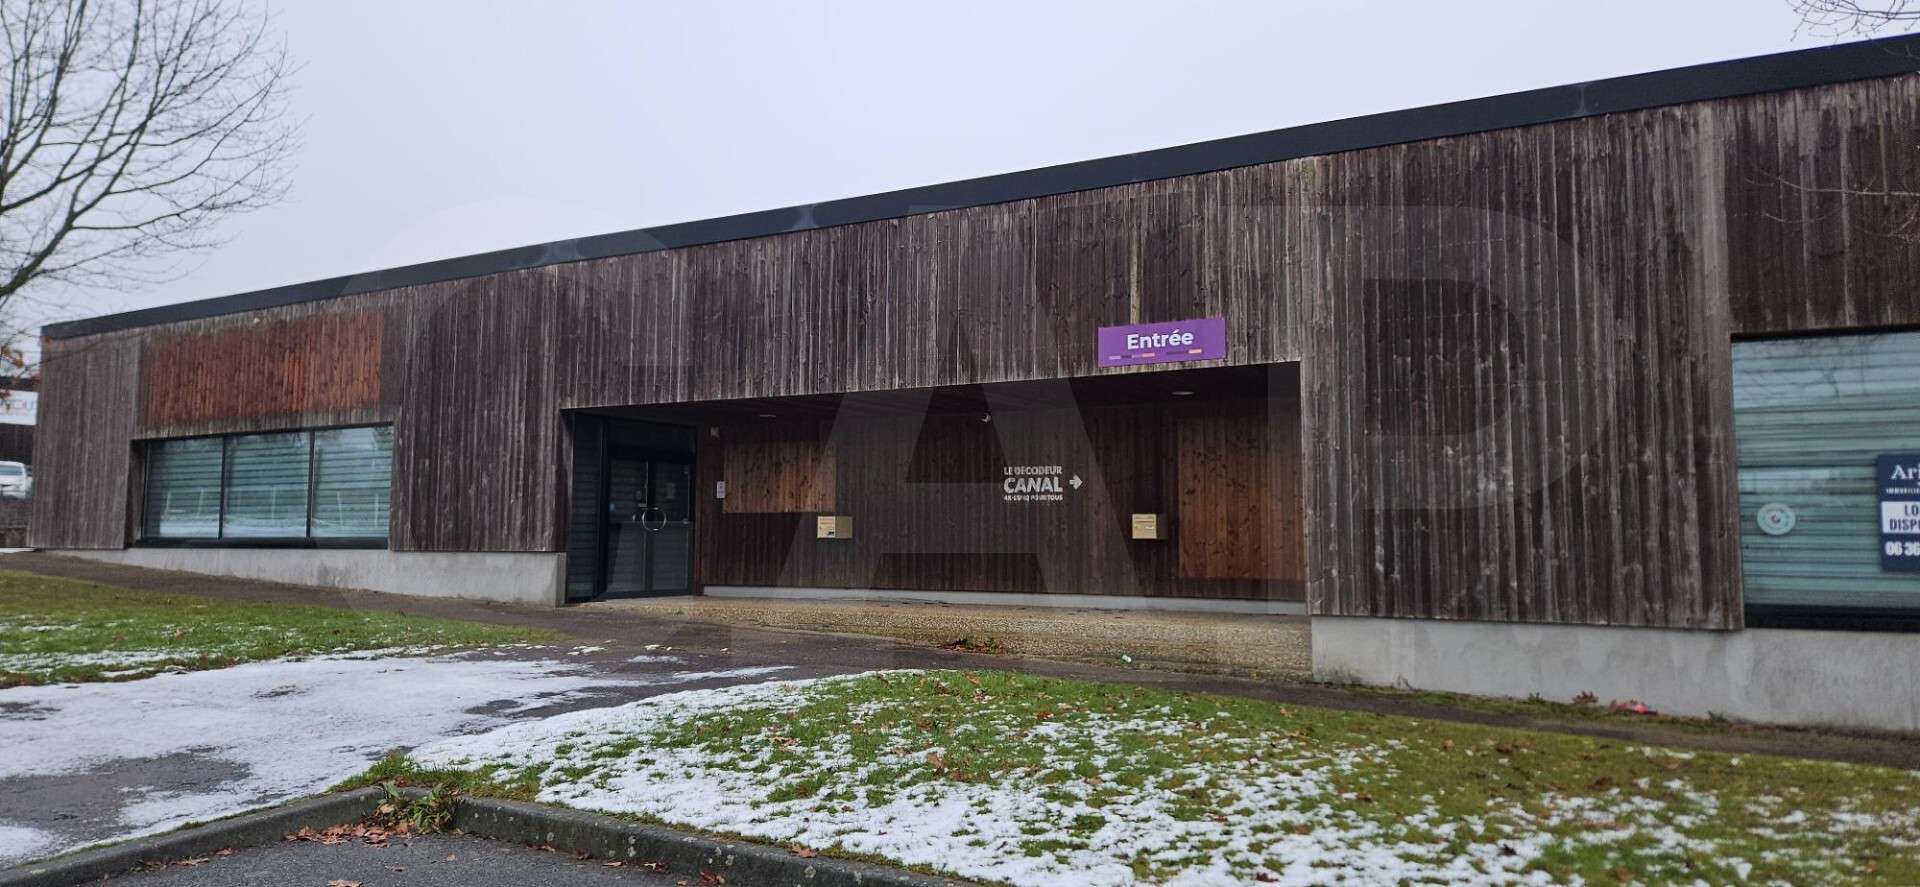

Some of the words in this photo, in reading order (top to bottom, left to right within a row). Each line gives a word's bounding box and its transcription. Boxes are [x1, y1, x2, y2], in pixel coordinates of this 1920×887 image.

[1127, 329, 1194, 350] Entrée
[1003, 466, 1013, 476] LE
[1014, 465, 1062, 475] DECODEUR
[1003, 476, 1063, 493] CANAL
[1889, 518, 1920, 531] DISP
[1885, 541, 1903, 556] 06
